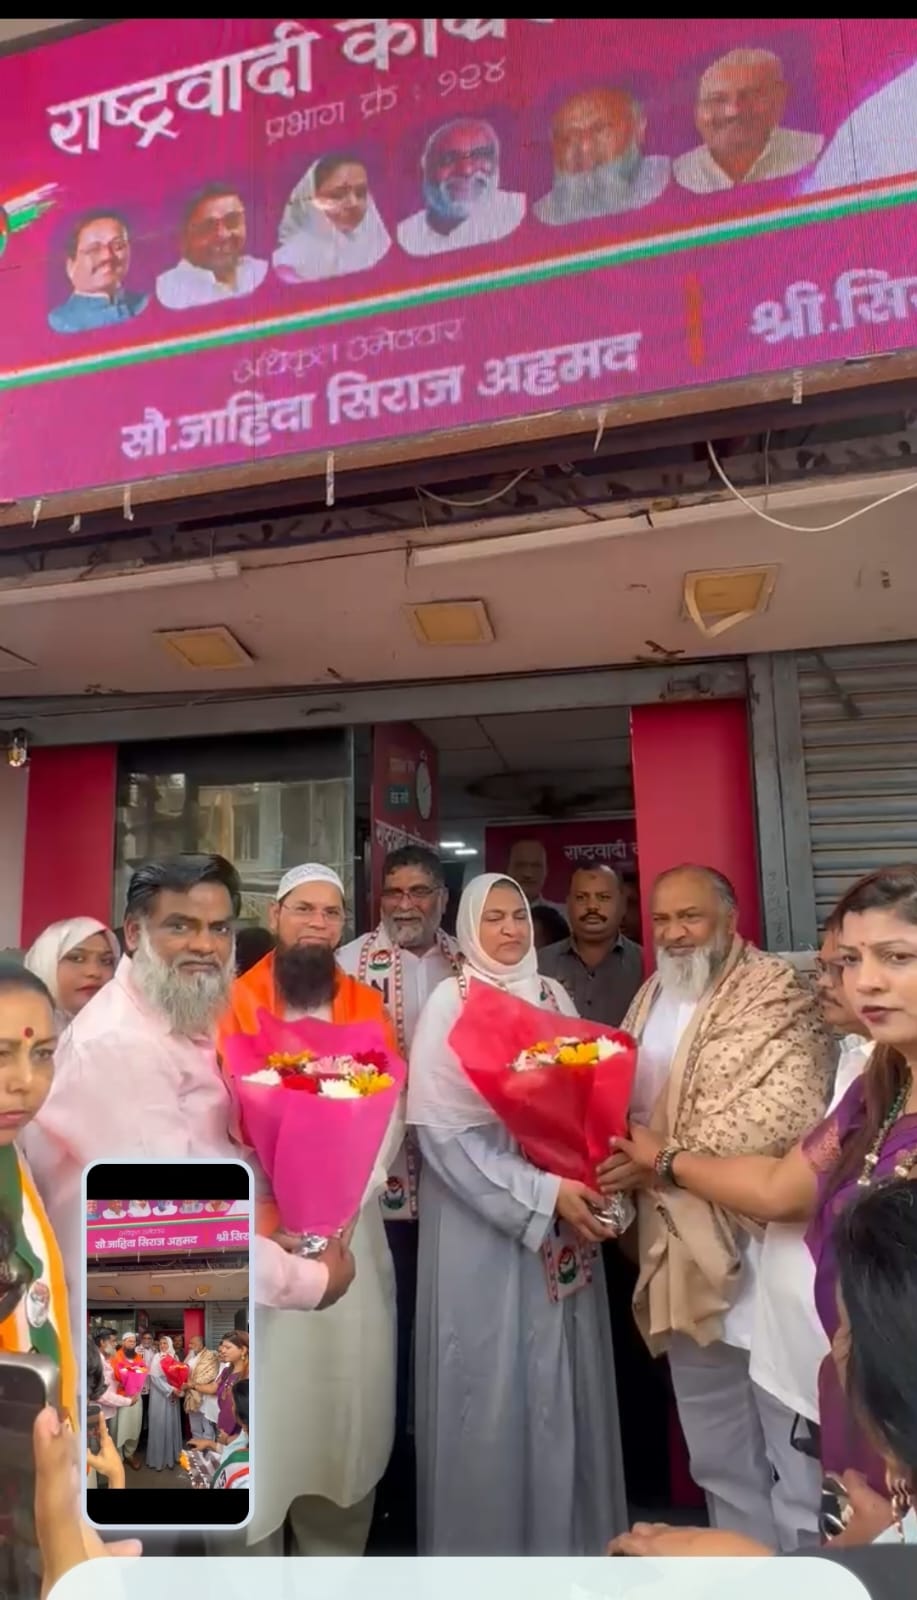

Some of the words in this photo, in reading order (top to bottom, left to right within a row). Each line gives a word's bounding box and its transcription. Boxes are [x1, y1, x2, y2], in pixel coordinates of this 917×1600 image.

[47, 21, 321, 155] राष्ट्रवादी
[326, 364, 465, 425] सिराज
[477, 331, 642, 395] अहमद
